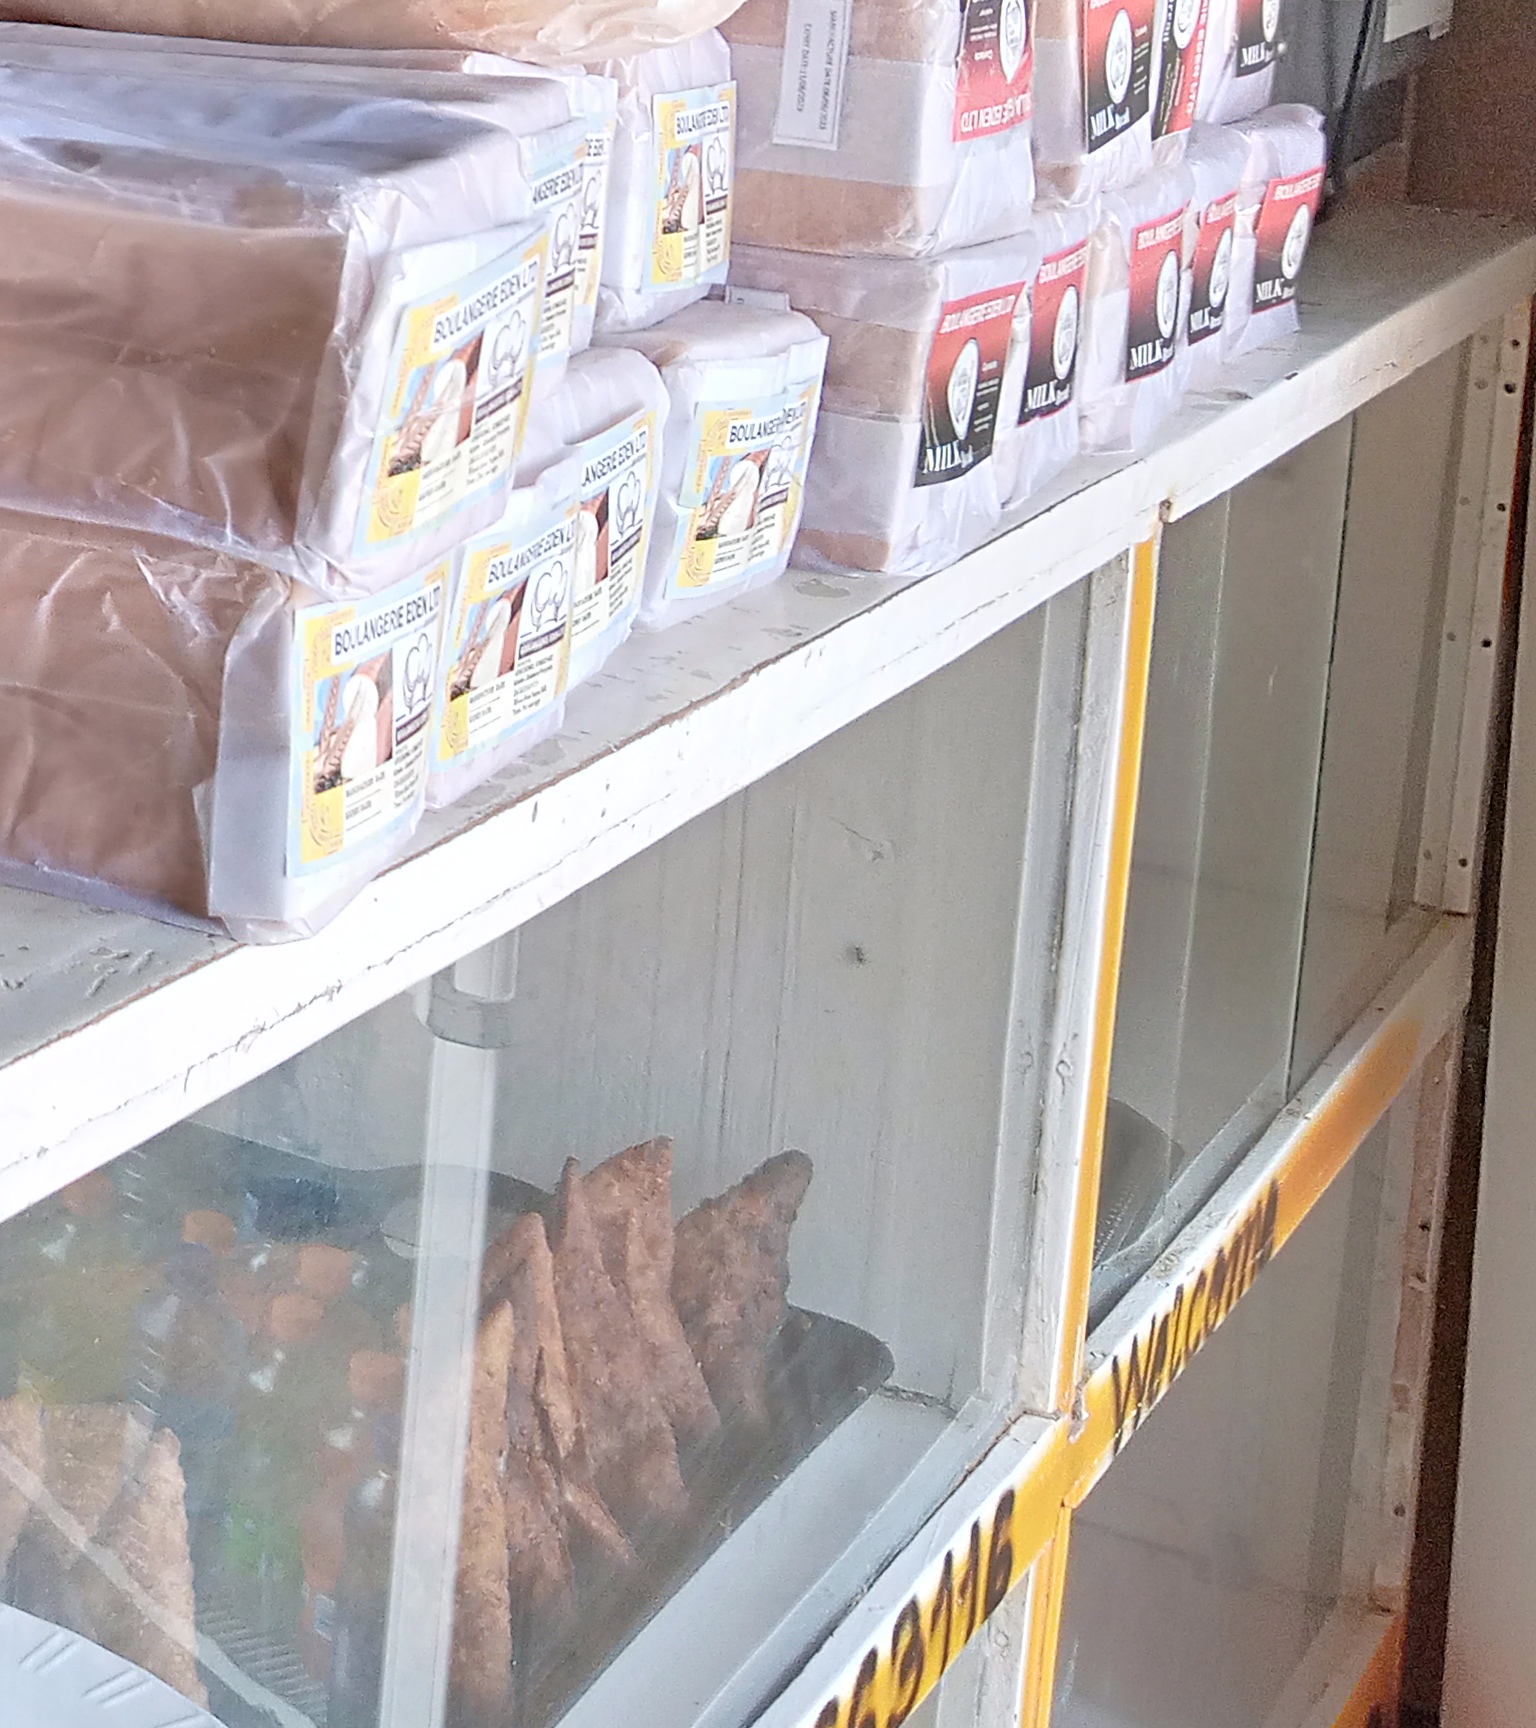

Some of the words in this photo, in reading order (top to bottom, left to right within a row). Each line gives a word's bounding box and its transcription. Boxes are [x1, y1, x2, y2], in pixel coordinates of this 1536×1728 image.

[1090, 103, 1116, 141] MILK
[1255, 278, 1285, 304] MILK
[1129, 338, 1164, 372] MILK
[1023, 379, 1059, 413] MILK
[922, 440, 963, 474] MILK
[334, 611, 405, 656] BOULANGERIE
[405, 598, 430, 626] EDEN
